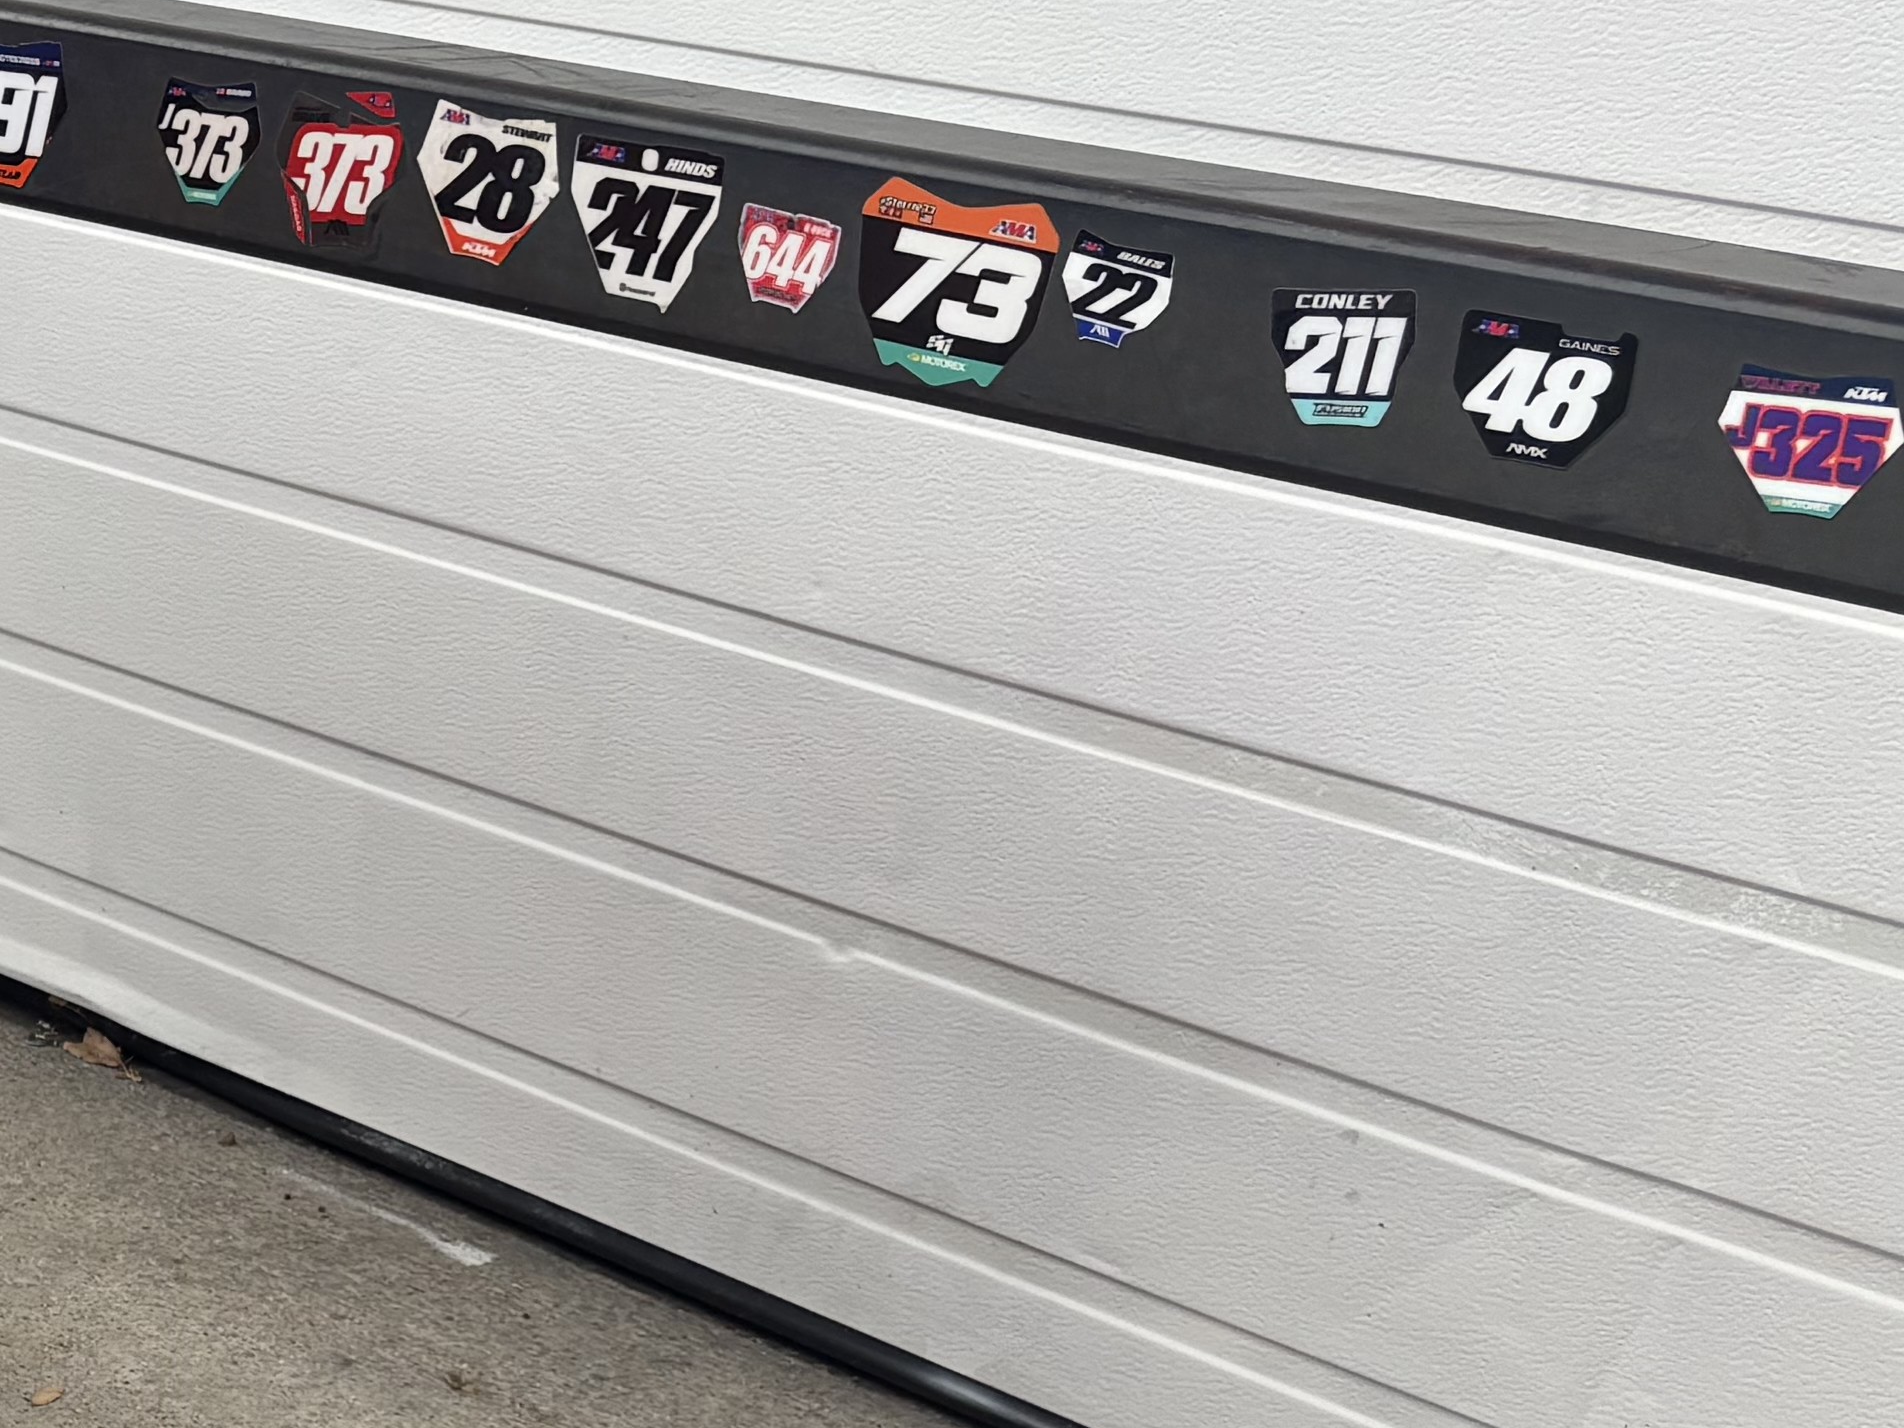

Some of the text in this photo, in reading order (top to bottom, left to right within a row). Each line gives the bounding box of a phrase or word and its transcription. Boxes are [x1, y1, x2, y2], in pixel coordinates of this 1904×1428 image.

[290, 131, 395, 215] 373
[434, 133, 546, 234] 28
[664, 157, 719, 179] HINDS
[461, 241, 497, 258] KTM
[587, 176, 717, 283] 247
[742, 224, 832, 295] 644
[989, 219, 1038, 244] AMA
[871, 227, 1043, 344] 73
[1070, 262, 1159, 330] 22
[1294, 293, 1394, 310] CONLEY
[1284, 315, 1409, 396] 211
[1558, 338, 1622, 356] GAINES
[1461, 347, 1613, 443] 48
[1842, 386, 1888, 403] KTM
[1724, 402, 1895, 491] J325
